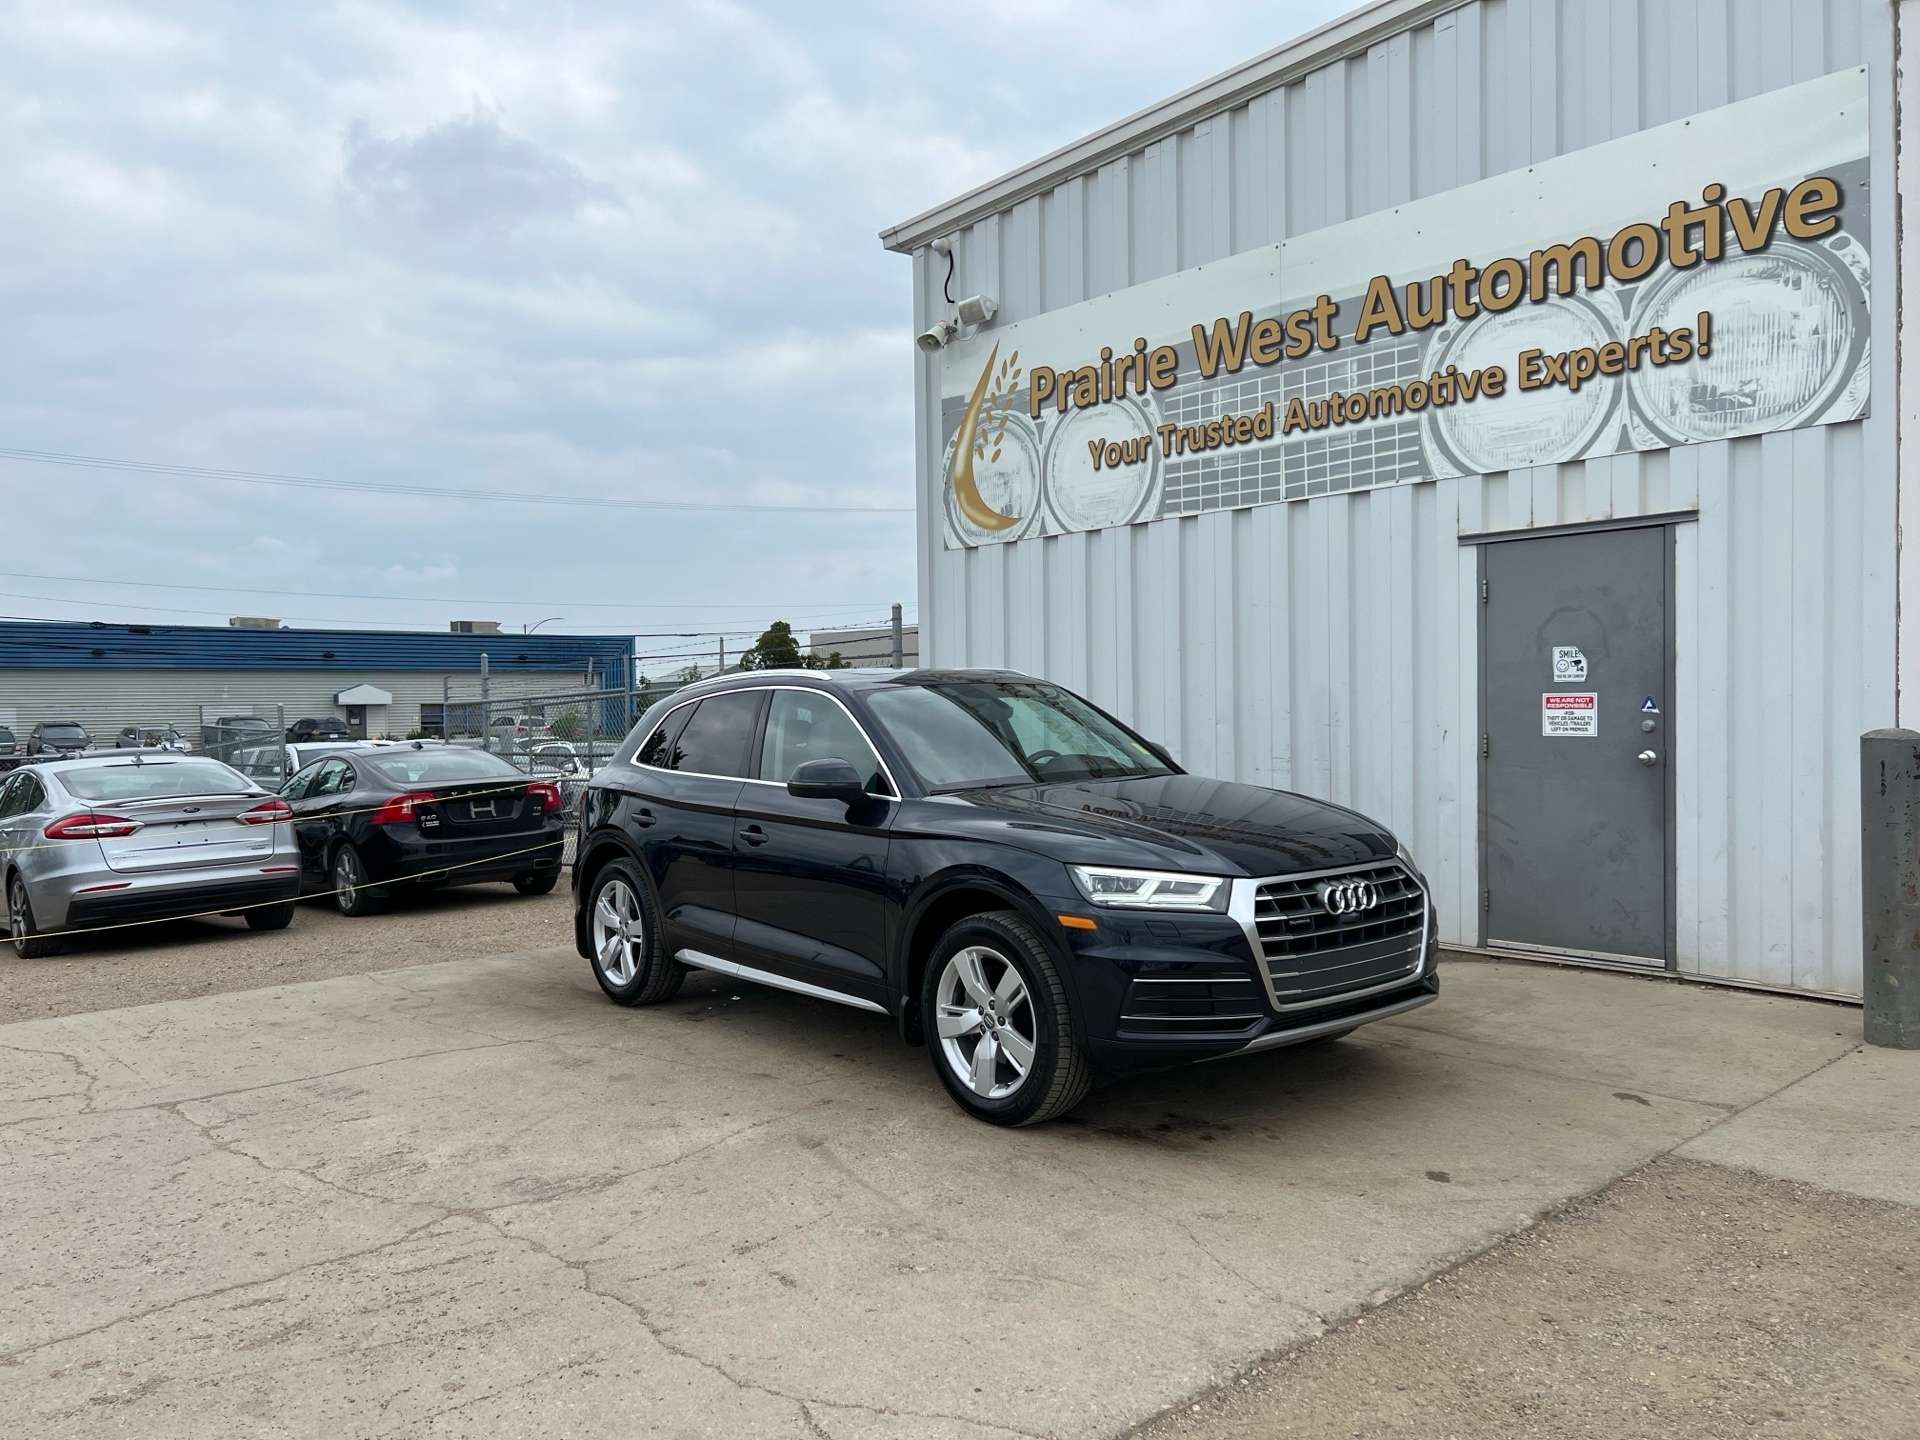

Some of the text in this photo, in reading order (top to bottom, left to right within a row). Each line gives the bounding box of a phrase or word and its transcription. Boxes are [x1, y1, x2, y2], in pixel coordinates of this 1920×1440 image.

[1028, 175, 1840, 418] Prairie West Automotive
[1089, 311, 1712, 471] Your Trusted Automotive Experts!
